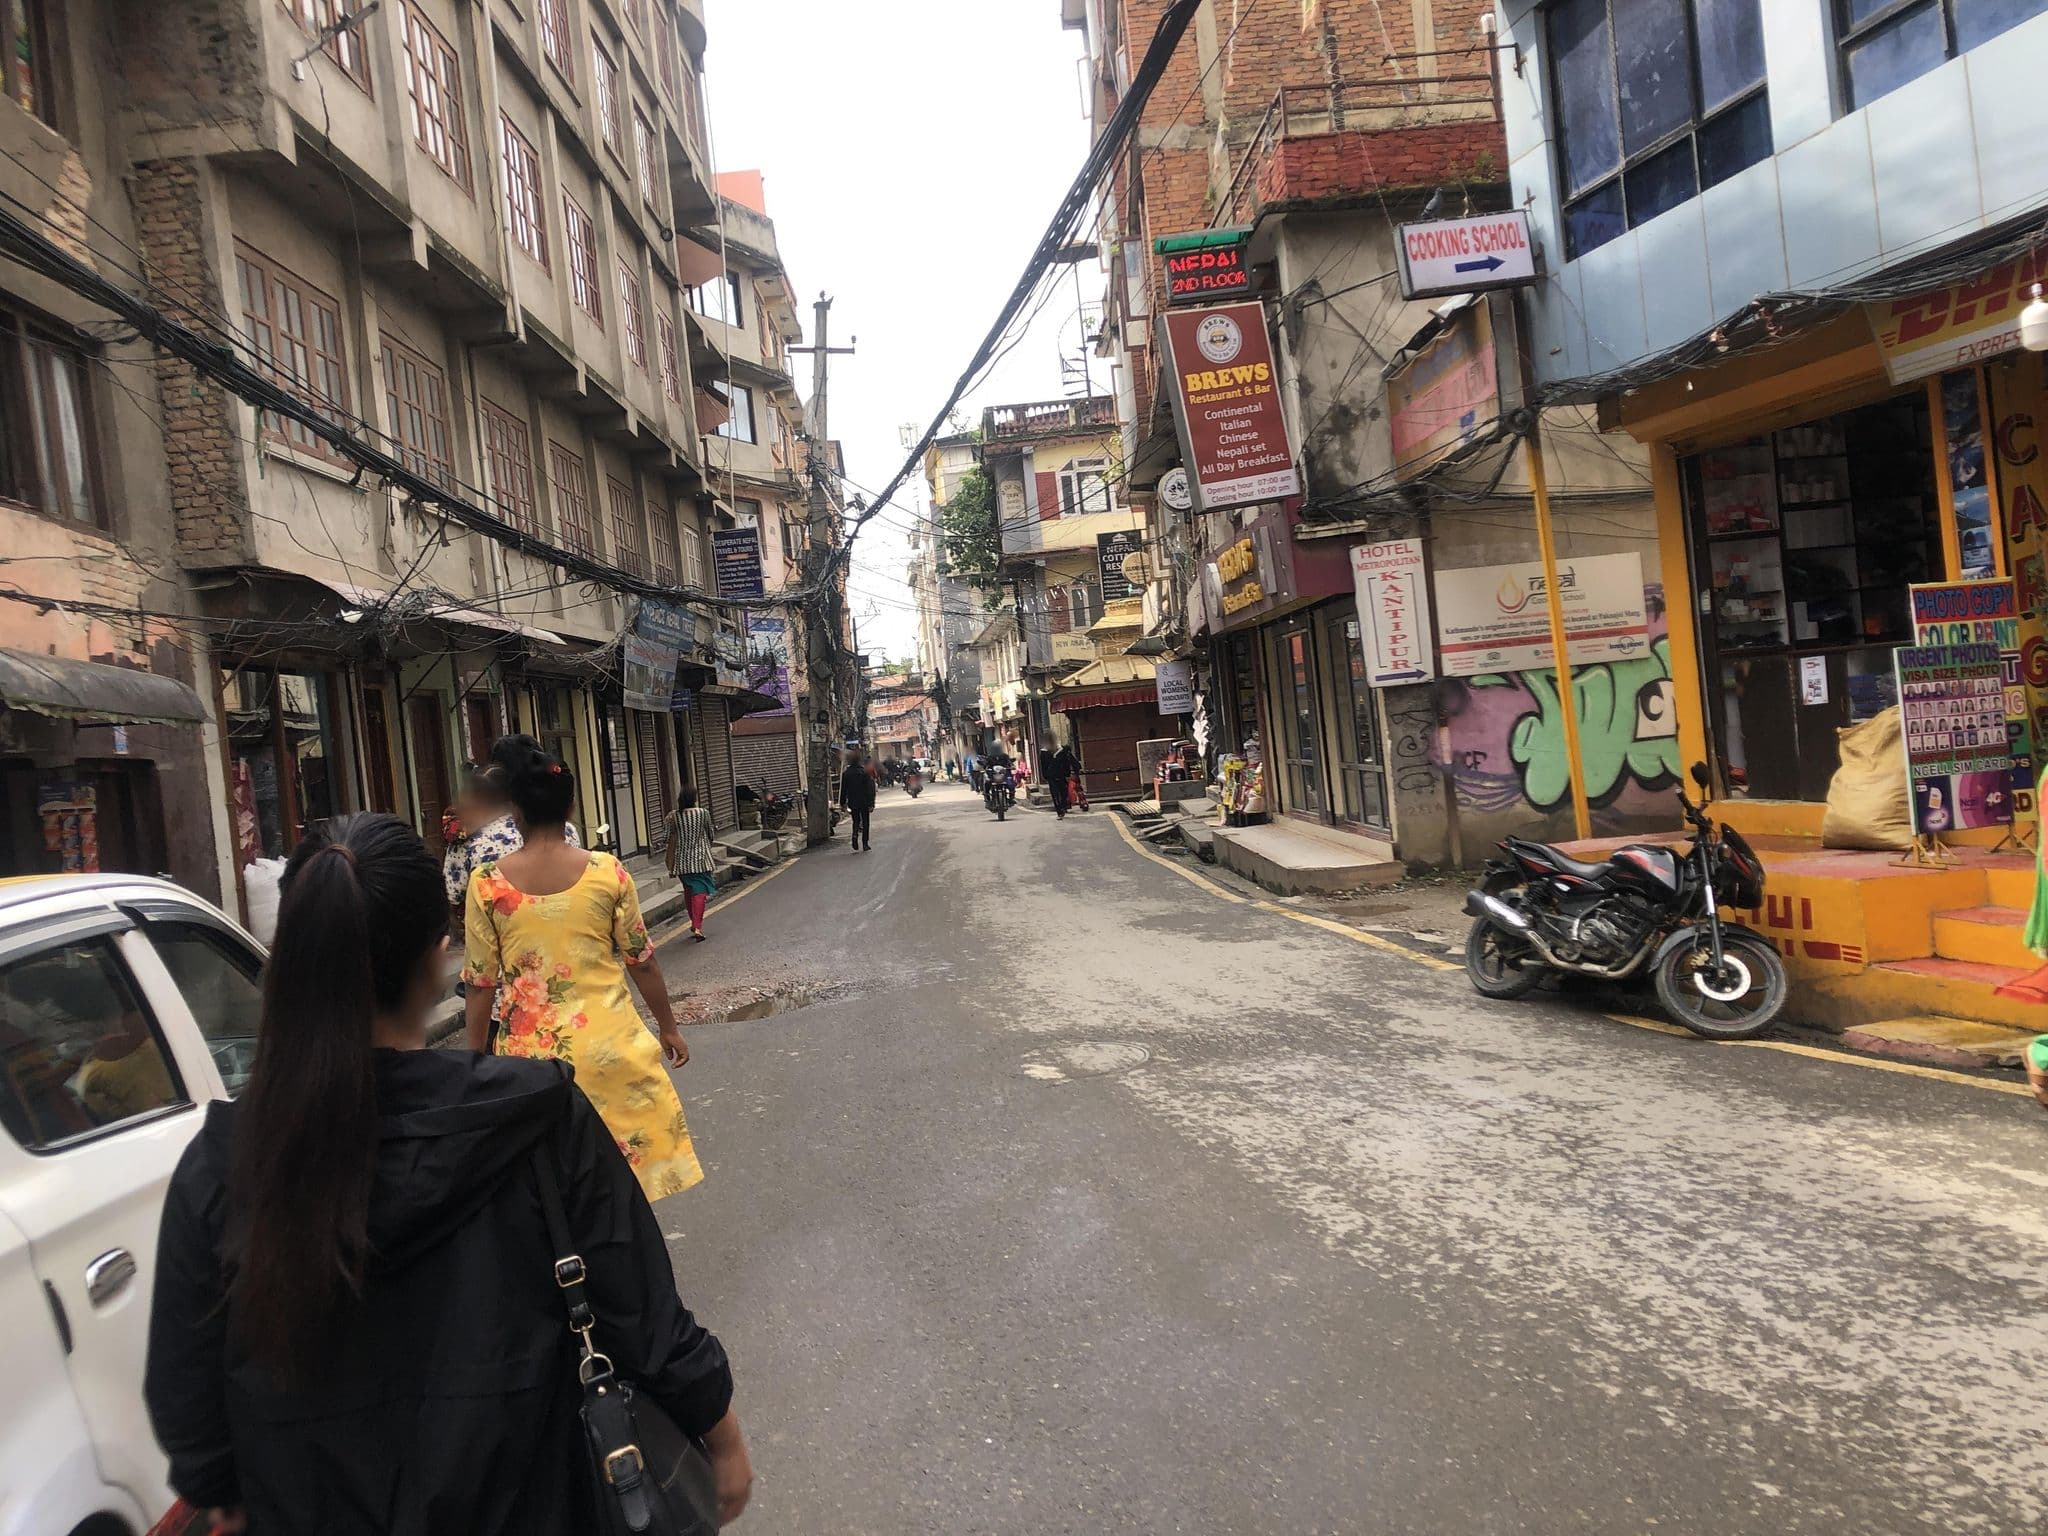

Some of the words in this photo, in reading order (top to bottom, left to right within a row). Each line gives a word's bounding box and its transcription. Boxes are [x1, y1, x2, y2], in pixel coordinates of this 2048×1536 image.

[1407, 227, 1470, 262] COOKING
[1472, 222, 1526, 253] SCHOOL
[1185, 363, 1270, 392] BREWS
[1190, 390, 1241, 404] Restaurant
[1244, 387, 1252, 395] &
[1255, 384, 1271, 394] Bar
[1204, 402, 1262, 420] Continental
[1220, 420, 1252, 431] Italian
[1219, 430, 1258, 444] Chinese
[1217, 446, 1248, 460] Nepali
[1251, 442, 1266, 452] set
[1202, 464, 1214, 475] All
[1217, 462, 1235, 472] Day
[1238, 452, 1288, 469] Breakfast.
[1206, 484, 1236, 495] Opening
[1238, 481, 1254, 489] hour
[1212, 493, 1238, 503] Closing
[1238, 490, 1254, 499] hour
[1102, 553, 1128, 562] COTT
[1106, 544, 1135, 554] NEPAL
[1360, 542, 1413, 558] HOTEL
[1357, 555, 1421, 571] METROPOLITAN
[1913, 588, 1968, 618] PHOTO
[1970, 585, 2014, 616] COPY
[1378, 570, 1412, 670] KANTIPUR
[1920, 624, 1970, 646] COLOR
[1974, 620, 2018, 649] PRINT
[1901, 648, 1948, 668] URGENT
[1951, 642, 2000, 664] PHOTOS
[1902, 670, 1930, 682] VISA
[1932, 667, 1958, 679] SIZE
[1960, 664, 2000, 677] PHOTO
[1164, 680, 1184, 688] LOCAL
[1913, 764, 1952, 778] NCELL
[1954, 760, 1973, 774] SIM
[1975, 757, 2008, 772] CARD
